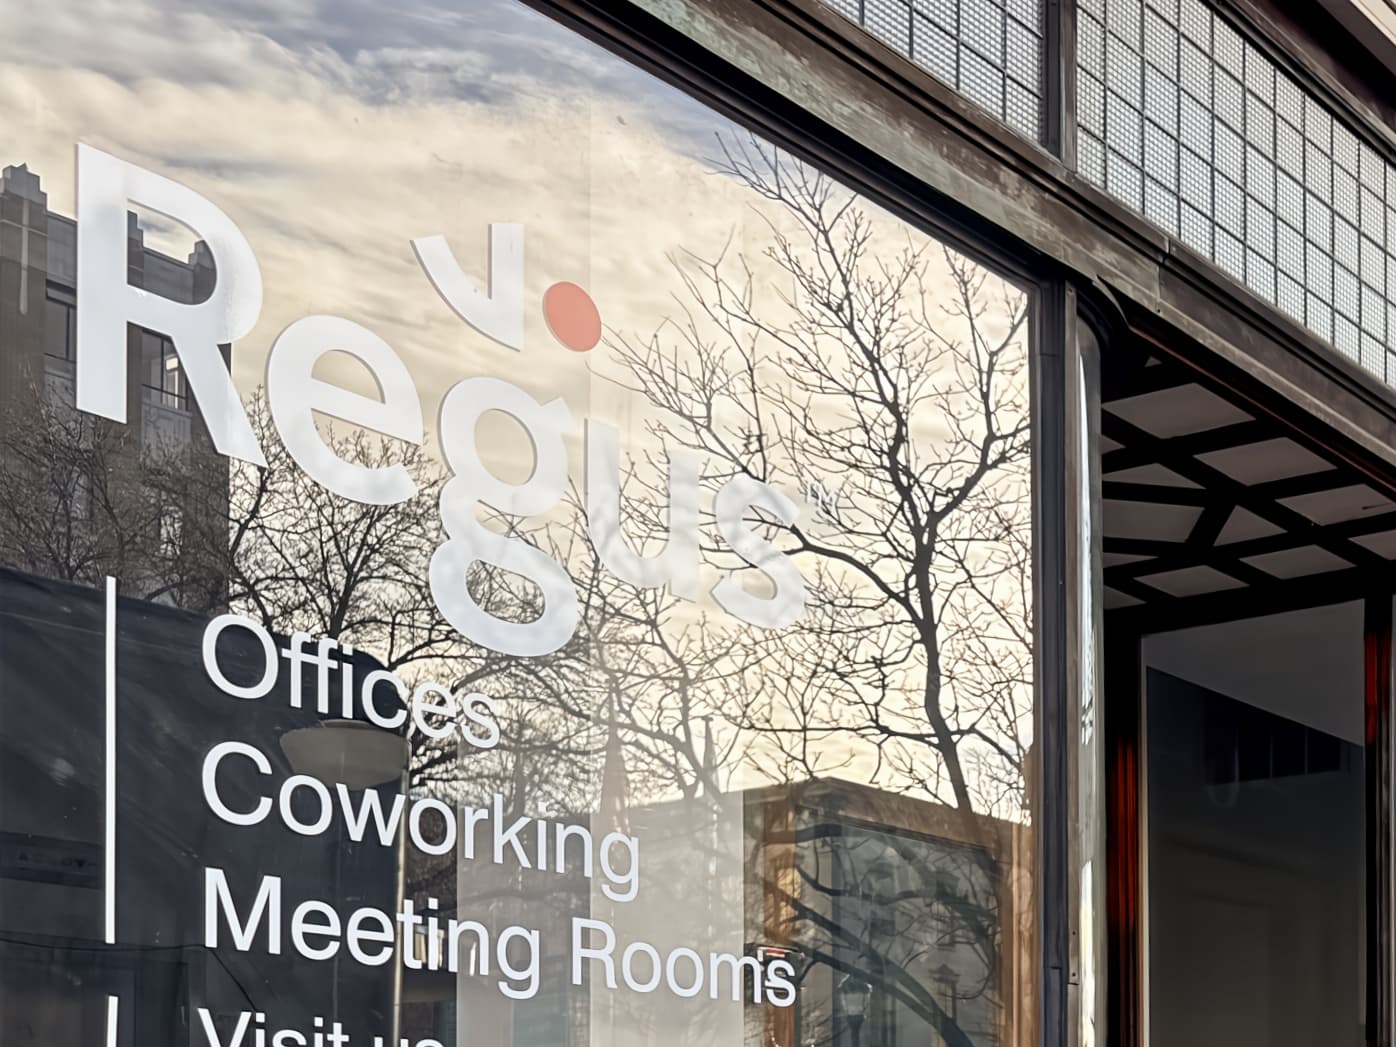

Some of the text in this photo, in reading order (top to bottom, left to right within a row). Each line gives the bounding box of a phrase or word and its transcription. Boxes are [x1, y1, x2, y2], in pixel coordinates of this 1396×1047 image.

[76, 142, 805, 656] Regus
[202, 614, 500, 750] Offices
[202, 741, 640, 902] Coworking
[202, 867, 797, 1008] Meeting Rooms
